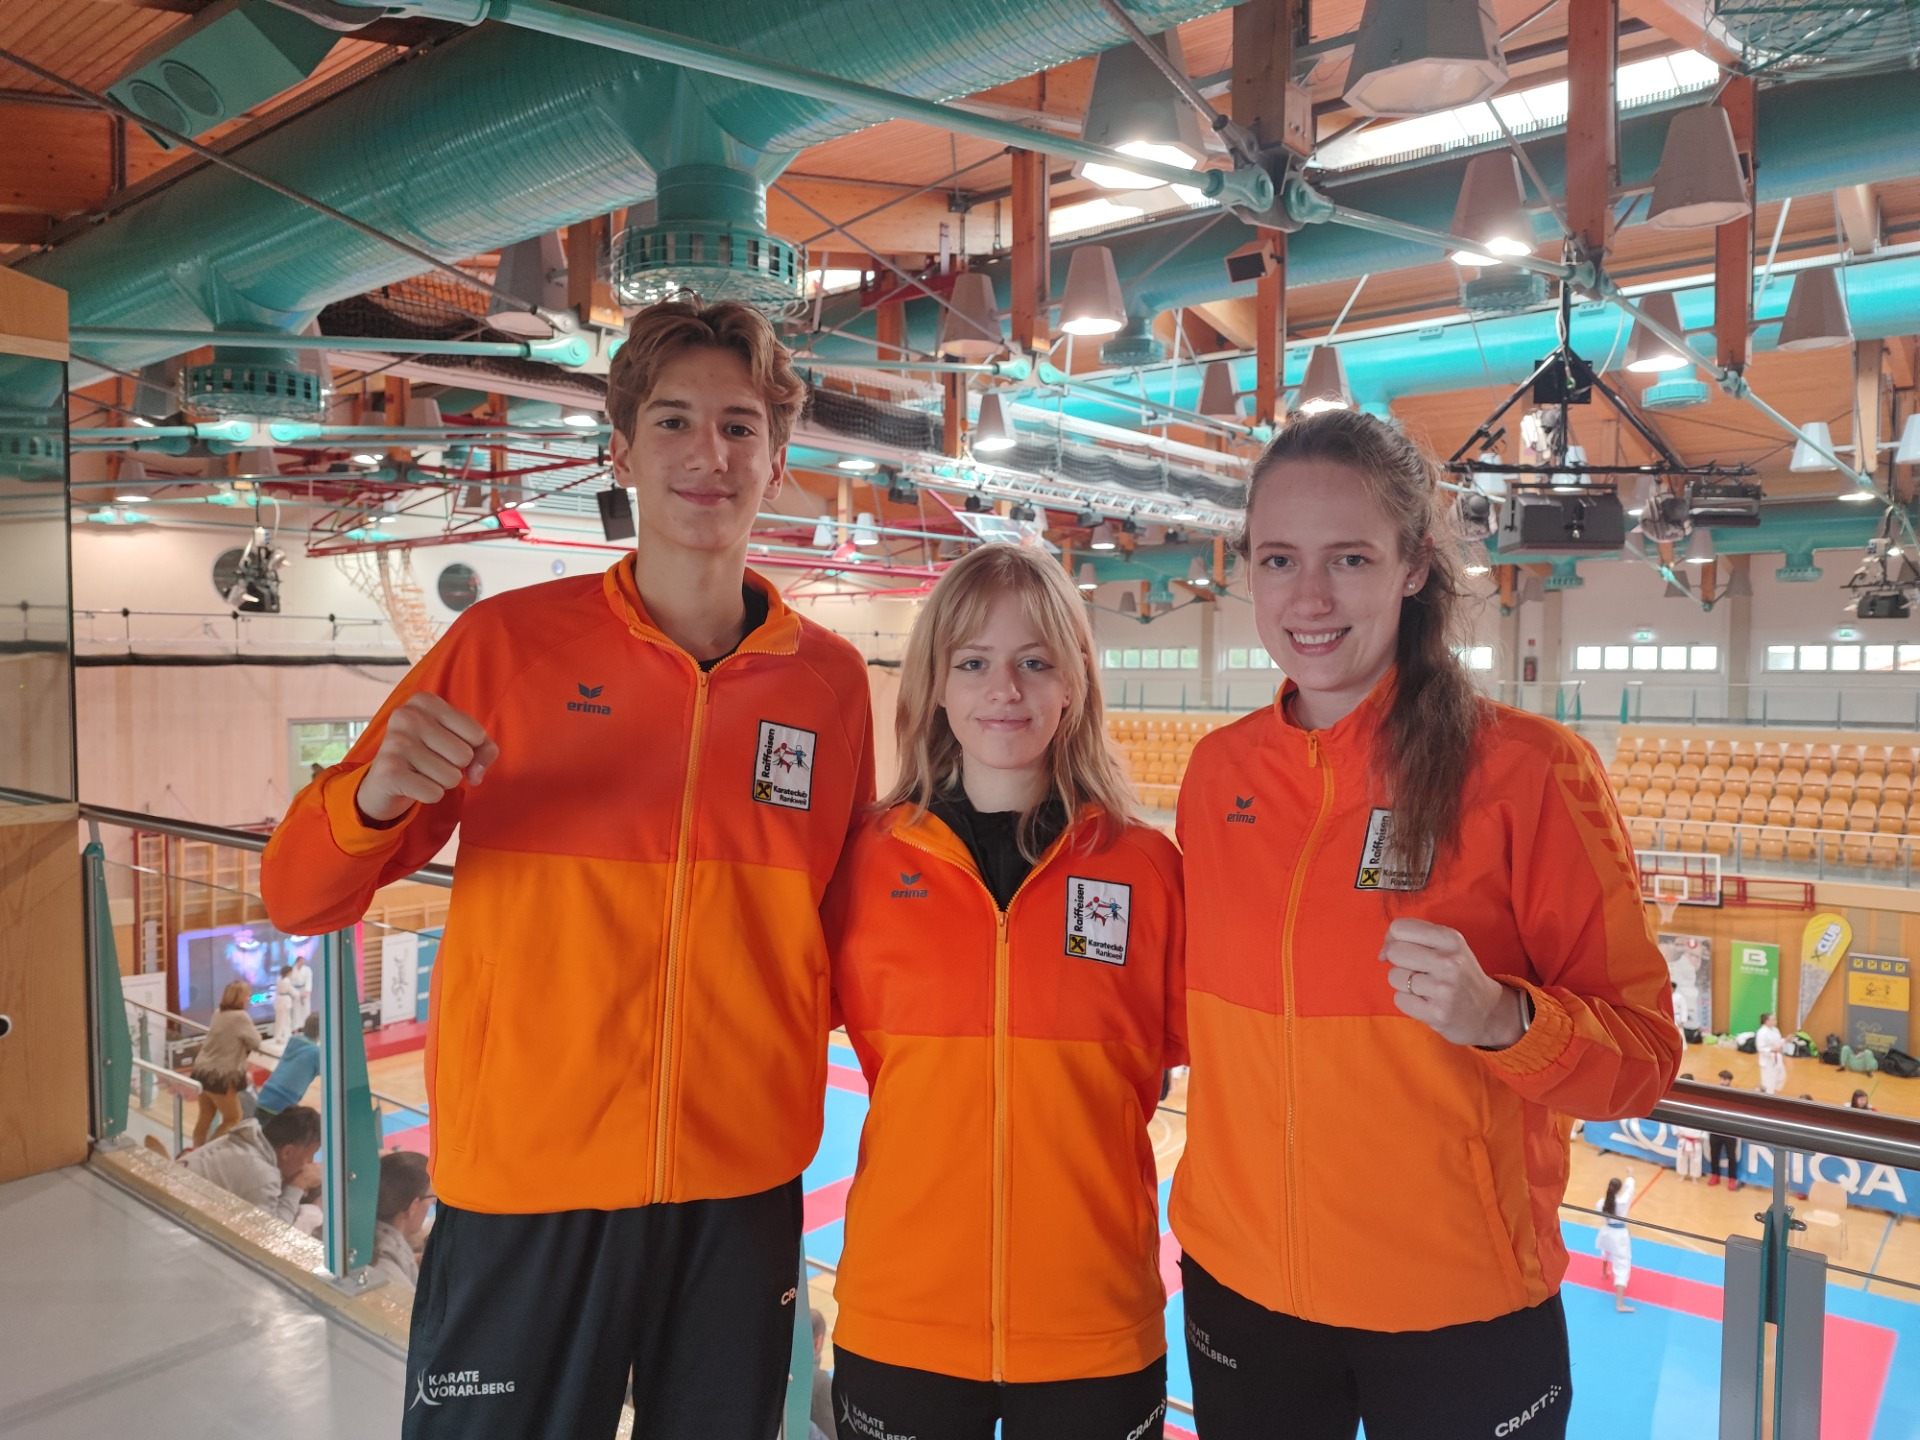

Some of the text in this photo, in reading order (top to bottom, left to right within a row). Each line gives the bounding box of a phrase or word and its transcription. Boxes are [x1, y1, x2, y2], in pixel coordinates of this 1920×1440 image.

[567, 701, 611, 715] erima
[762, 728, 775, 778] Raiffeisen
[773, 785, 807, 798] Karateclub
[1227, 812, 1256, 823] erima
[1369, 815, 1391, 864] Raiffeisen
[891, 888, 928, 898] erima
[1074, 884, 1084, 932] Raiffeisen
[1088, 939, 1124, 952] Karateclub
[1096, 948, 1122, 961] Rankweil
[428, 1370, 479, 1386] KARATE
[429, 1381, 515, 1398] VORARLBERG
[853, 1404, 885, 1430] KARATE
[1495, 1393, 1548, 1437] CRAFT
